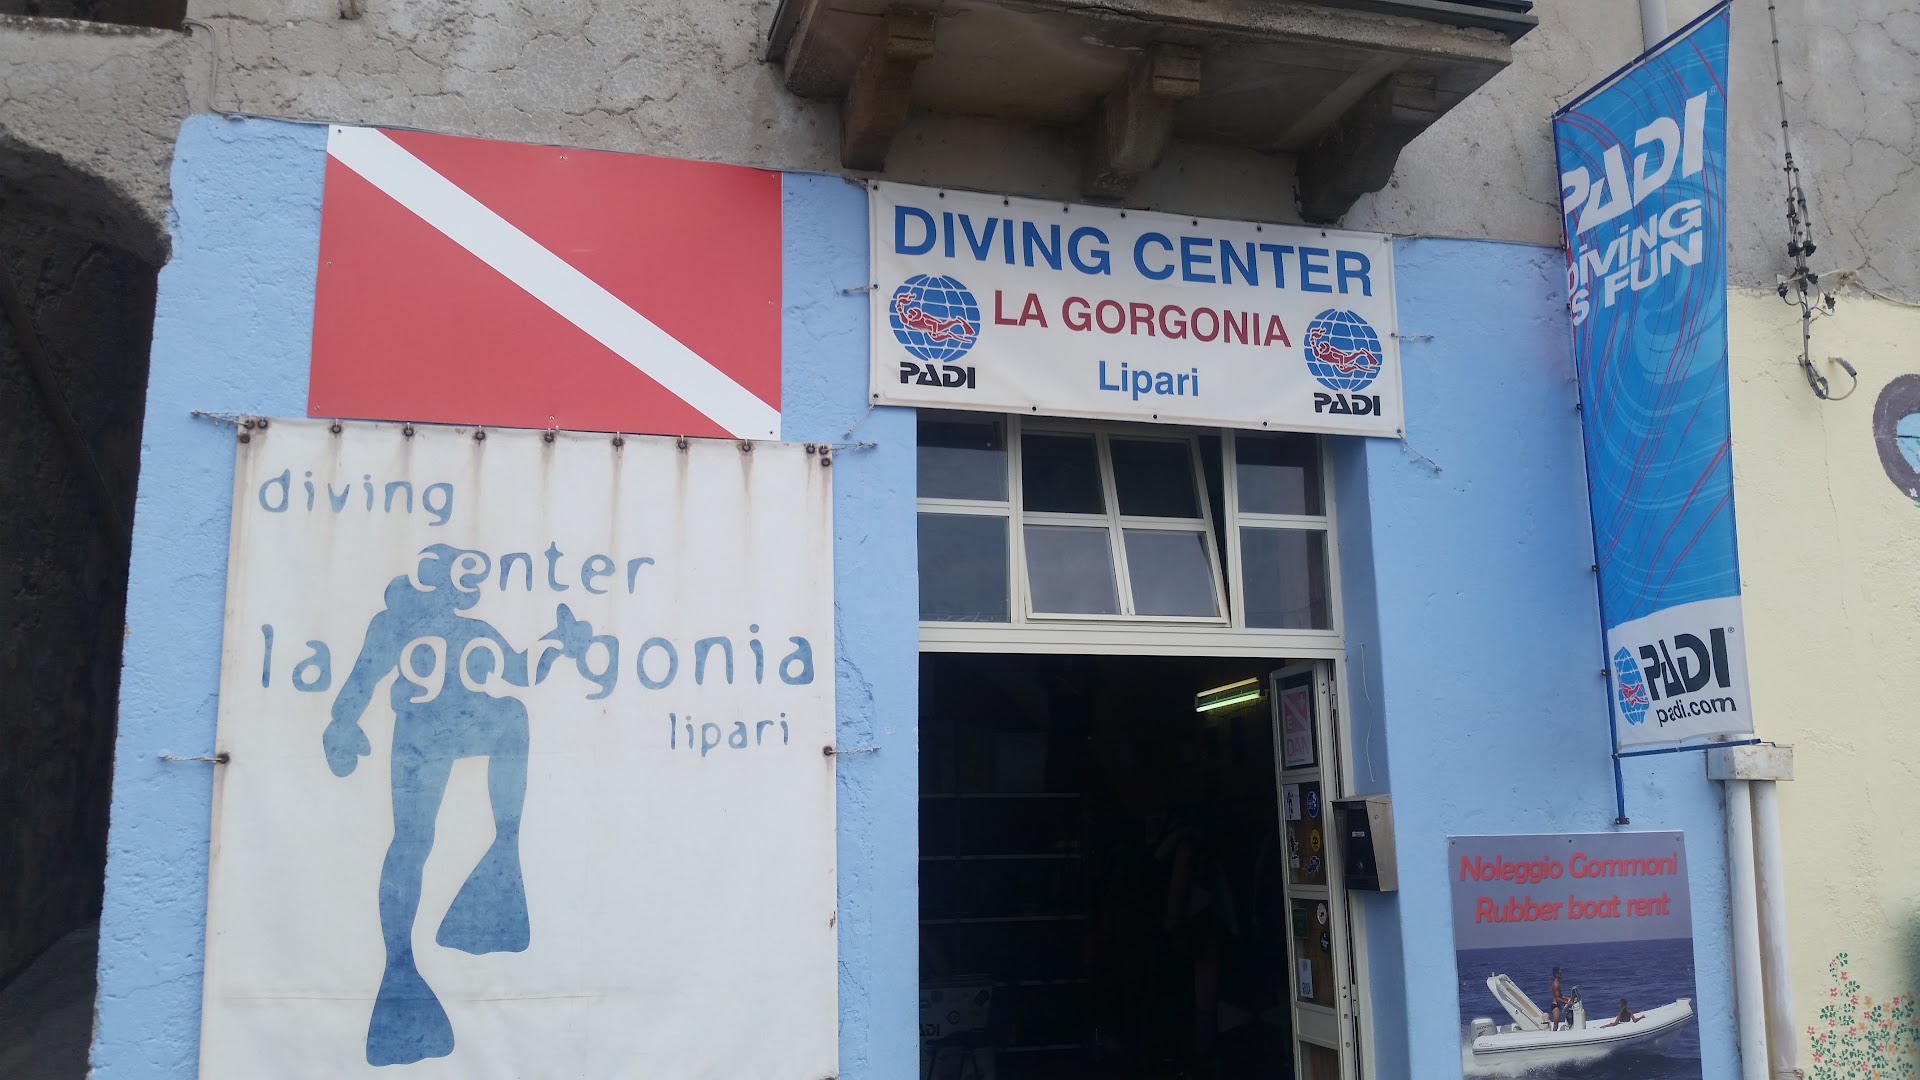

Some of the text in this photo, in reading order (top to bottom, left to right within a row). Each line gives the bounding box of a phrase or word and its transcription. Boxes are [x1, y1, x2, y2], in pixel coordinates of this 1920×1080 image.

[894, 205, 1373, 297] DIVING CENTER
[1604, 229, 1703, 308] FUN
[994, 290, 1292, 348] LA GORGONIA
[899, 361, 976, 389] PADI
[1099, 360, 1200, 401] Lipari
[1313, 392, 1382, 417] PADI
[259, 468, 454, 526] diving
[413, 541, 656, 595] center
[261, 623, 816, 703] la gorgonia
[1656, 696, 1737, 727] padi.com
[669, 712, 790, 757] lipari
[1460, 851, 1678, 884] Noleggio Gommoni
[1475, 891, 1671, 923] Rubber boat rent
